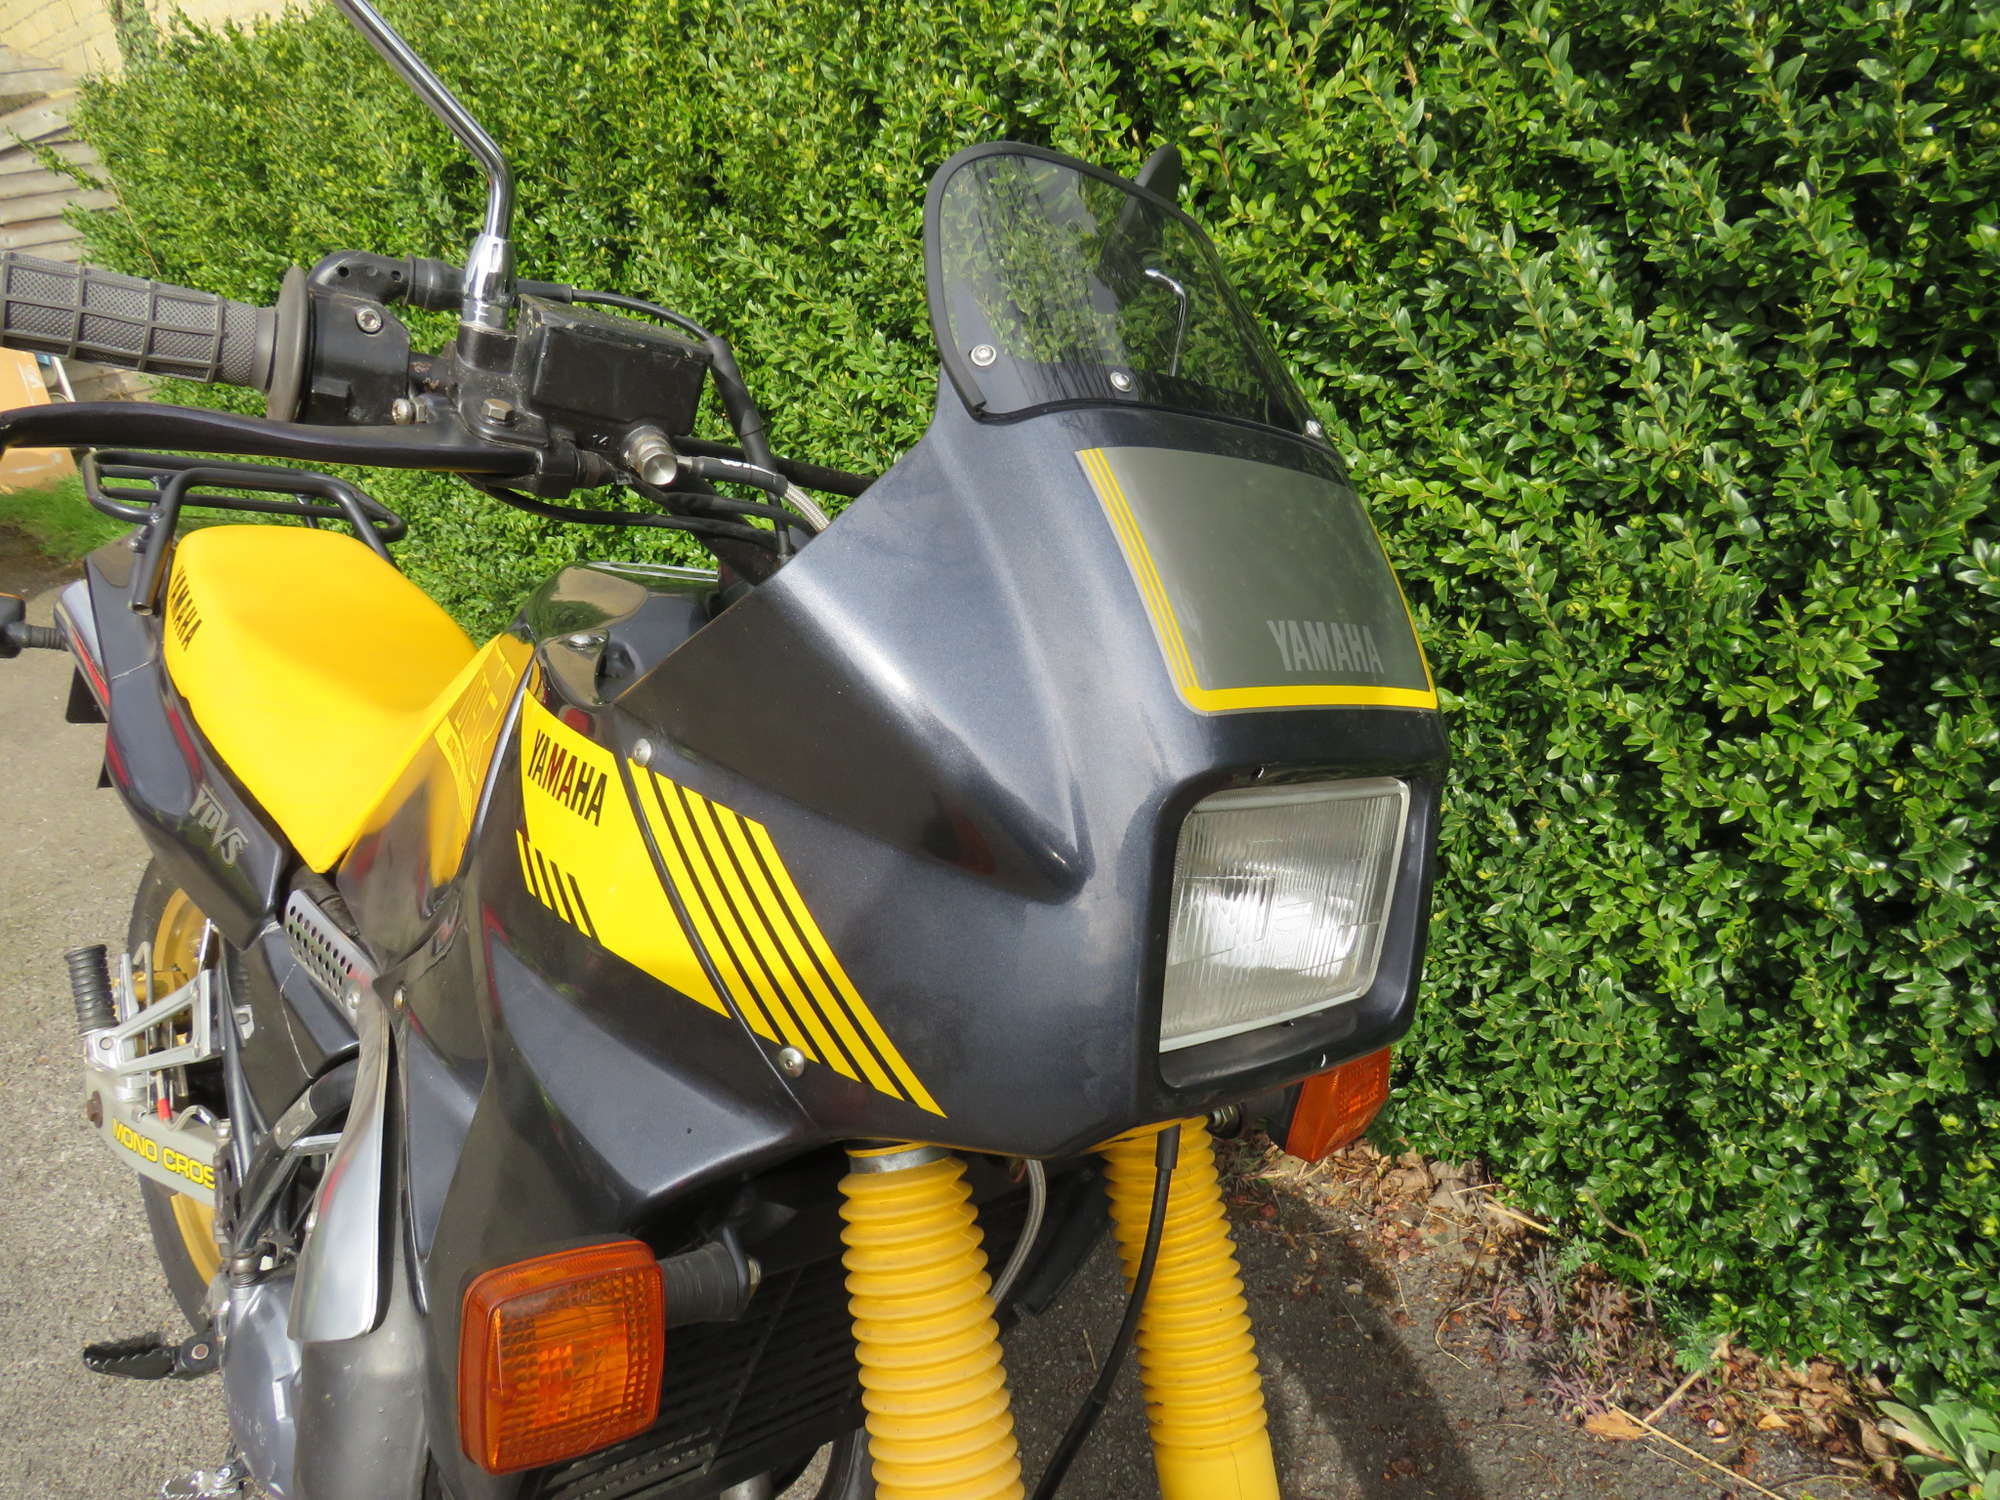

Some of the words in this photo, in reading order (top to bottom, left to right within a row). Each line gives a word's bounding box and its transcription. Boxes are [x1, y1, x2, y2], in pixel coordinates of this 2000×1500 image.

[169, 566, 202, 652] YAMAHA
[1266, 619, 1385, 674] YAMAHA
[527, 729, 608, 827] YAMAHA
[112, 1118, 158, 1163] MONO
